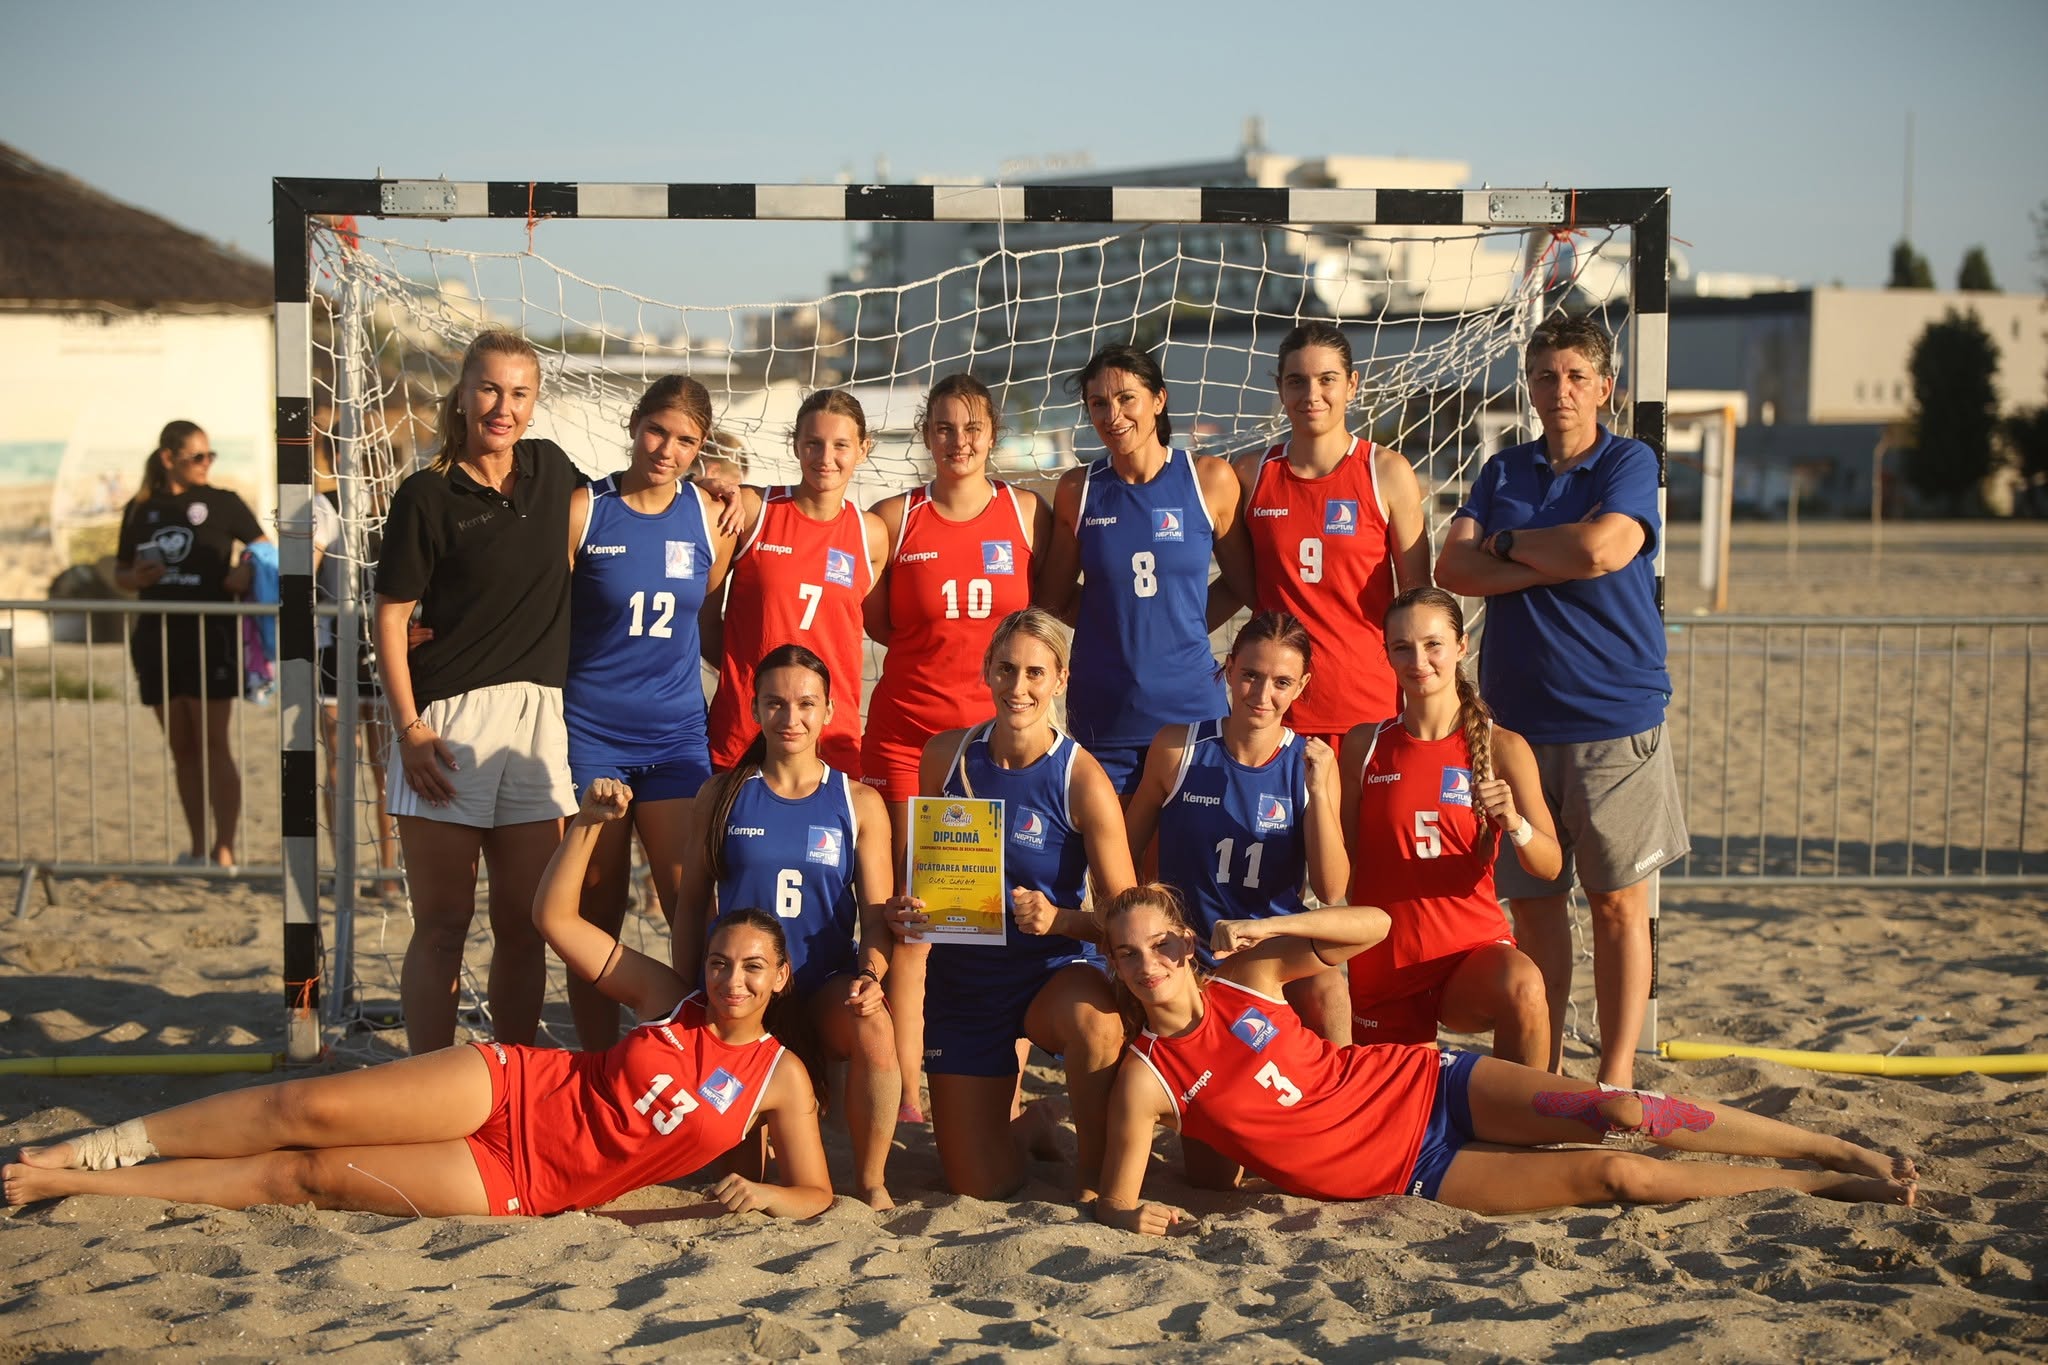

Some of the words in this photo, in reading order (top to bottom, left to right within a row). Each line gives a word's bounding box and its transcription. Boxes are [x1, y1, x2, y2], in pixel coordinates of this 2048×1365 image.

[458, 511, 495, 532] Kempa
[1085, 516, 1117, 527] Kempa
[1254, 507, 1288, 518] Kempa
[587, 544, 626, 556] Kempa
[756, 542, 793, 555] Kempa
[900, 551, 938, 563] Kempa
[1299, 537, 1323, 584] 9
[1132, 551, 1158, 598] 8
[799, 582, 823, 630] 7
[941, 578, 992, 619] 10
[629, 591, 676, 638] 12
[1367, 772, 1401, 785] Kempa
[1183, 791, 1220, 807] Kempa
[727, 825, 765, 838] Kempa
[933, 829, 980, 844] DIPLOMĂ
[1014, 832, 1043, 845] NEPTUN
[1415, 811, 1442, 859] 5
[962, 865, 997, 874] MECIULUI
[1215, 837, 1264, 889] 11
[1635, 848, 1664, 873] Kempa
[776, 868, 803, 918] 6
[1352, 1012, 1378, 1028] empa
[660, 1026, 685, 1051] empa
[1180, 1069, 1213, 1104] Kempa
[1254, 1060, 1304, 1107] 3
[633, 1073, 700, 1136] 13
